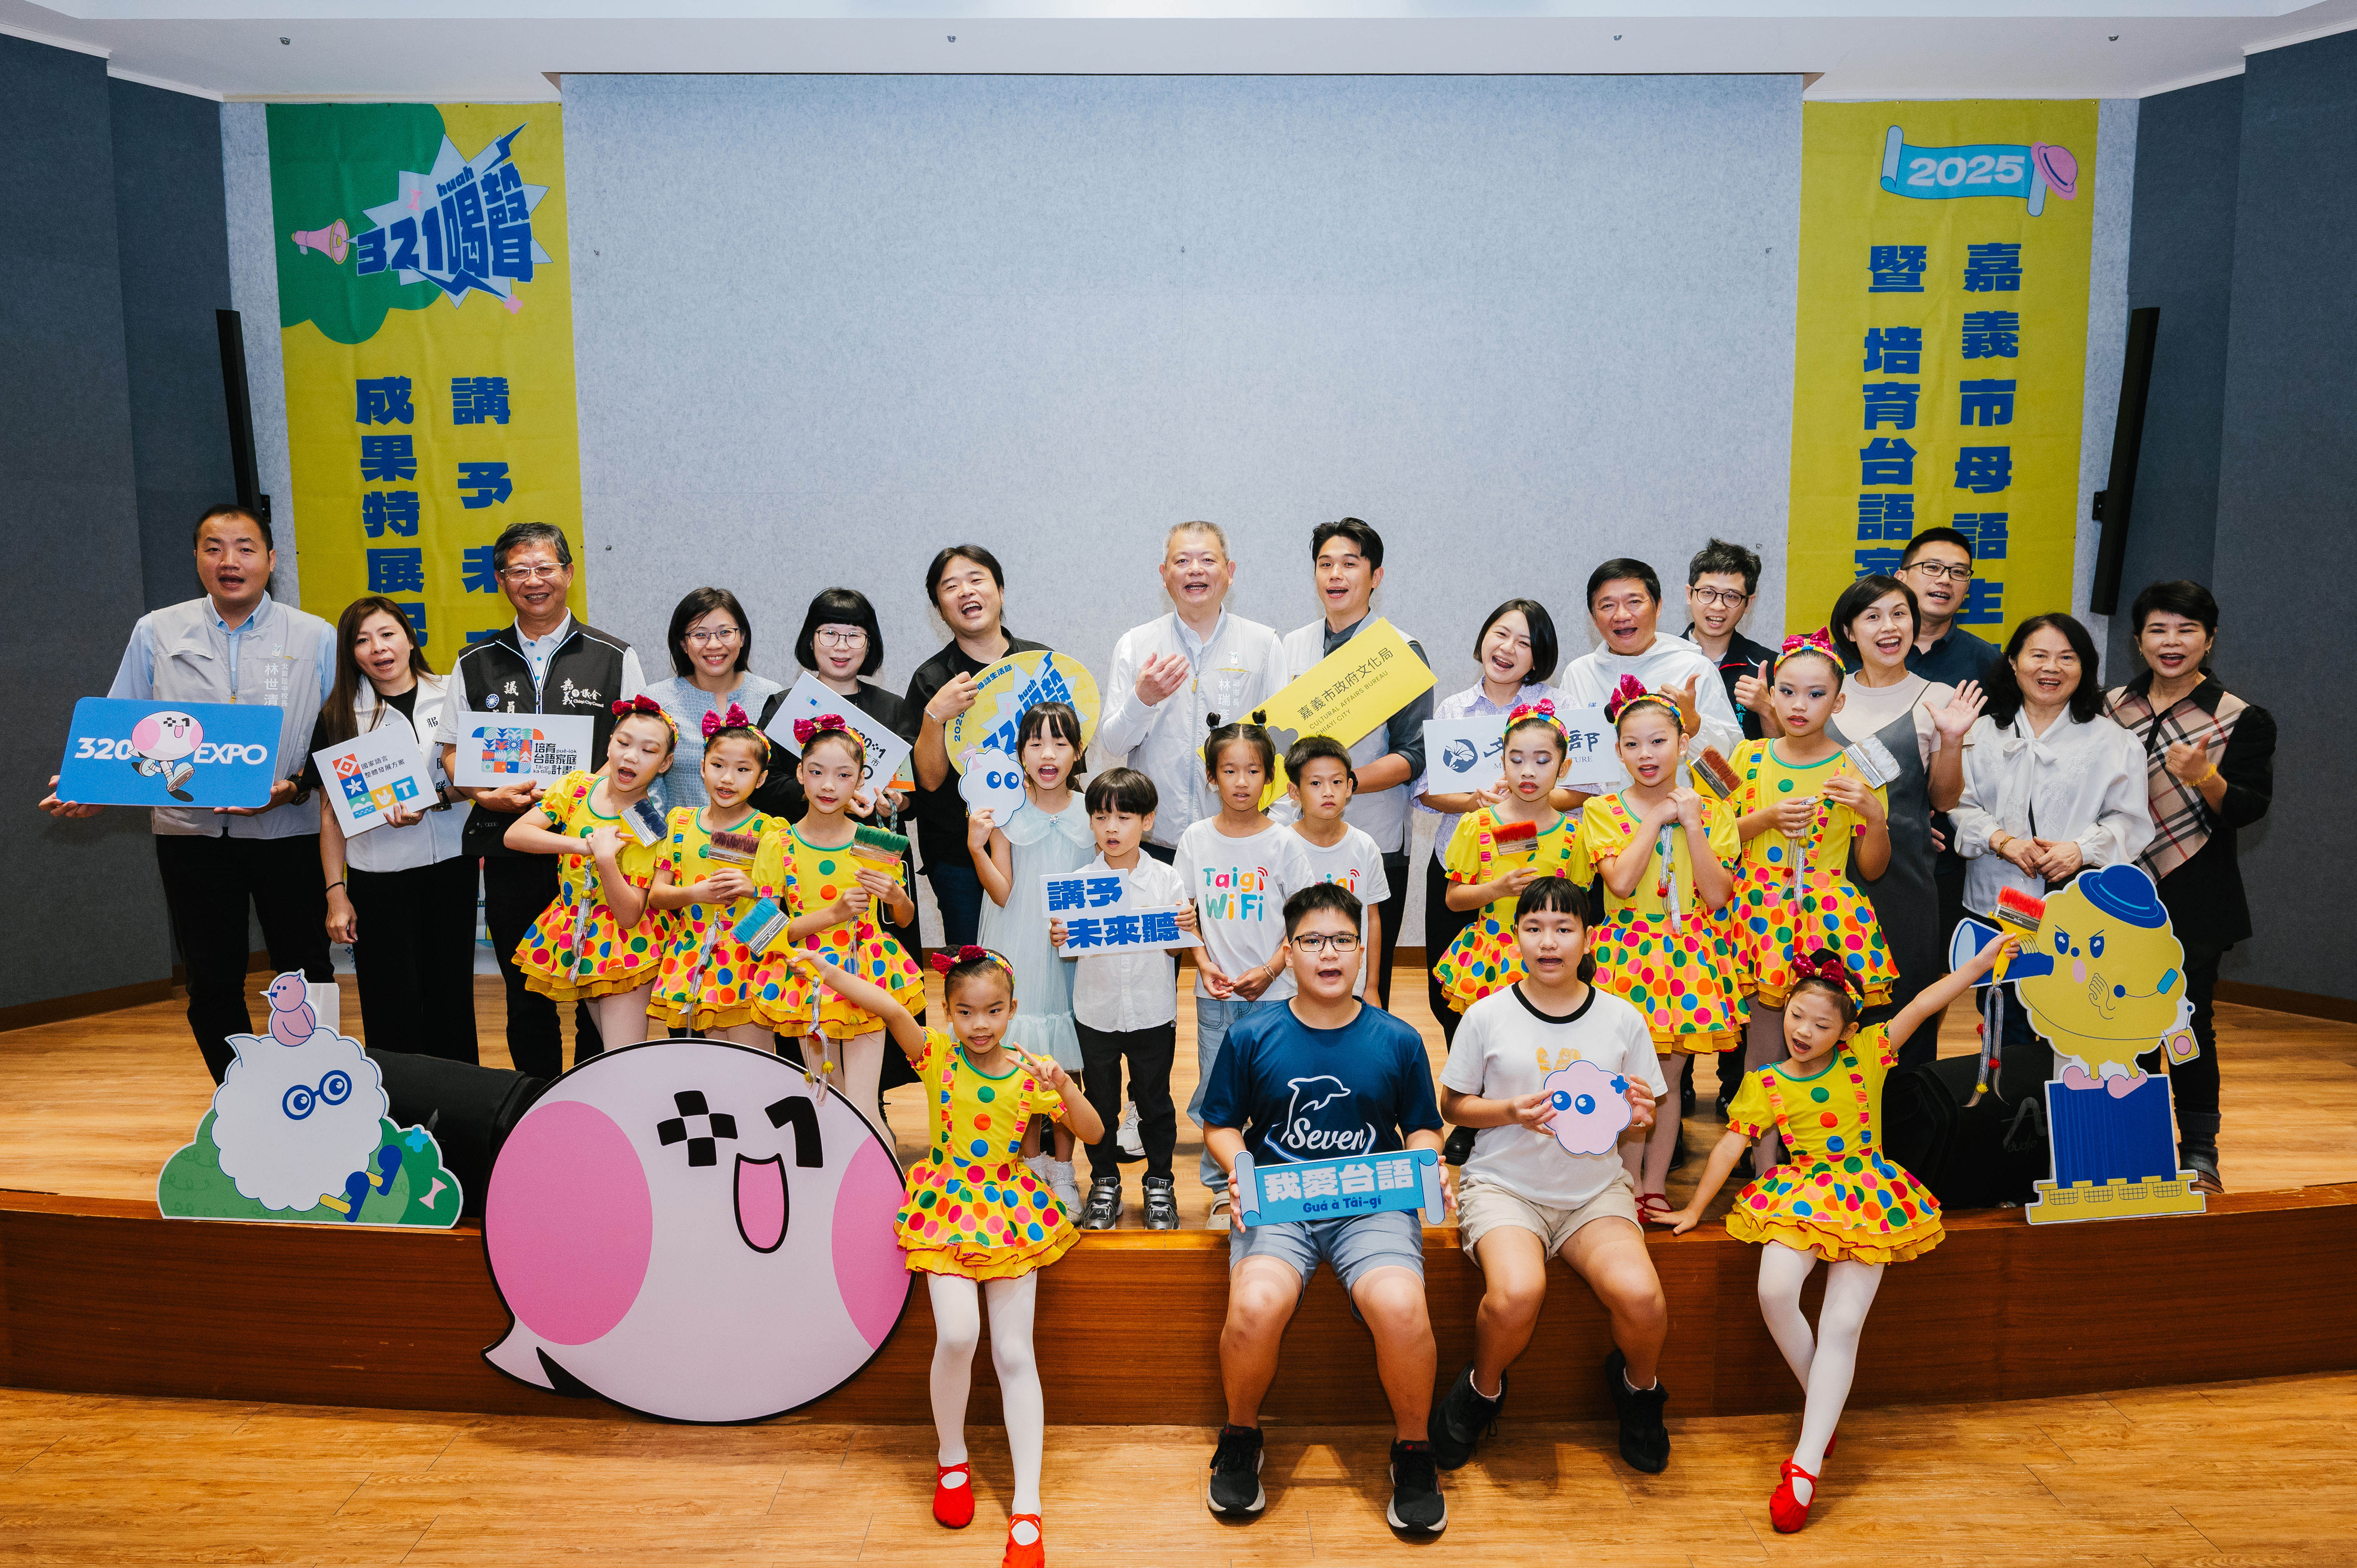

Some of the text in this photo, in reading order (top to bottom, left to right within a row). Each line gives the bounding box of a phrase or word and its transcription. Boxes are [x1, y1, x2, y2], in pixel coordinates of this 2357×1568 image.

[436, 166, 474, 198] huah
[1907, 155, 2025, 186] 2025
[1952, 243, 2023, 650] 嘉義市母語生
[263, 663, 279, 706] 林世清
[1018, 679, 1037, 702] huah
[1297, 647, 1393, 721] 嘉義市政府文化局
[1309, 670, 1388, 729] CULTURAL AFFAIRS BUREAU
[1316, 708, 1352, 736] CHIAYI CITY
[74, 737, 267, 765] 320 EXPO
[361, 756, 388, 770] 國家語言
[534, 753, 577, 765] 台語家庭
[535, 742, 556, 753] 培育
[364, 759, 405, 779] 整體發展方案
[1047, 877, 1123, 911] 講予
[1203, 867, 1268, 892] Taigi
[1066, 912, 1180, 949] 未來聽
[1287, 1118, 1366, 1150] Seven
[1264, 1158, 1414, 1202] 我愛台語
[1303, 1195, 1382, 1213] Guá à Tâi-gí
